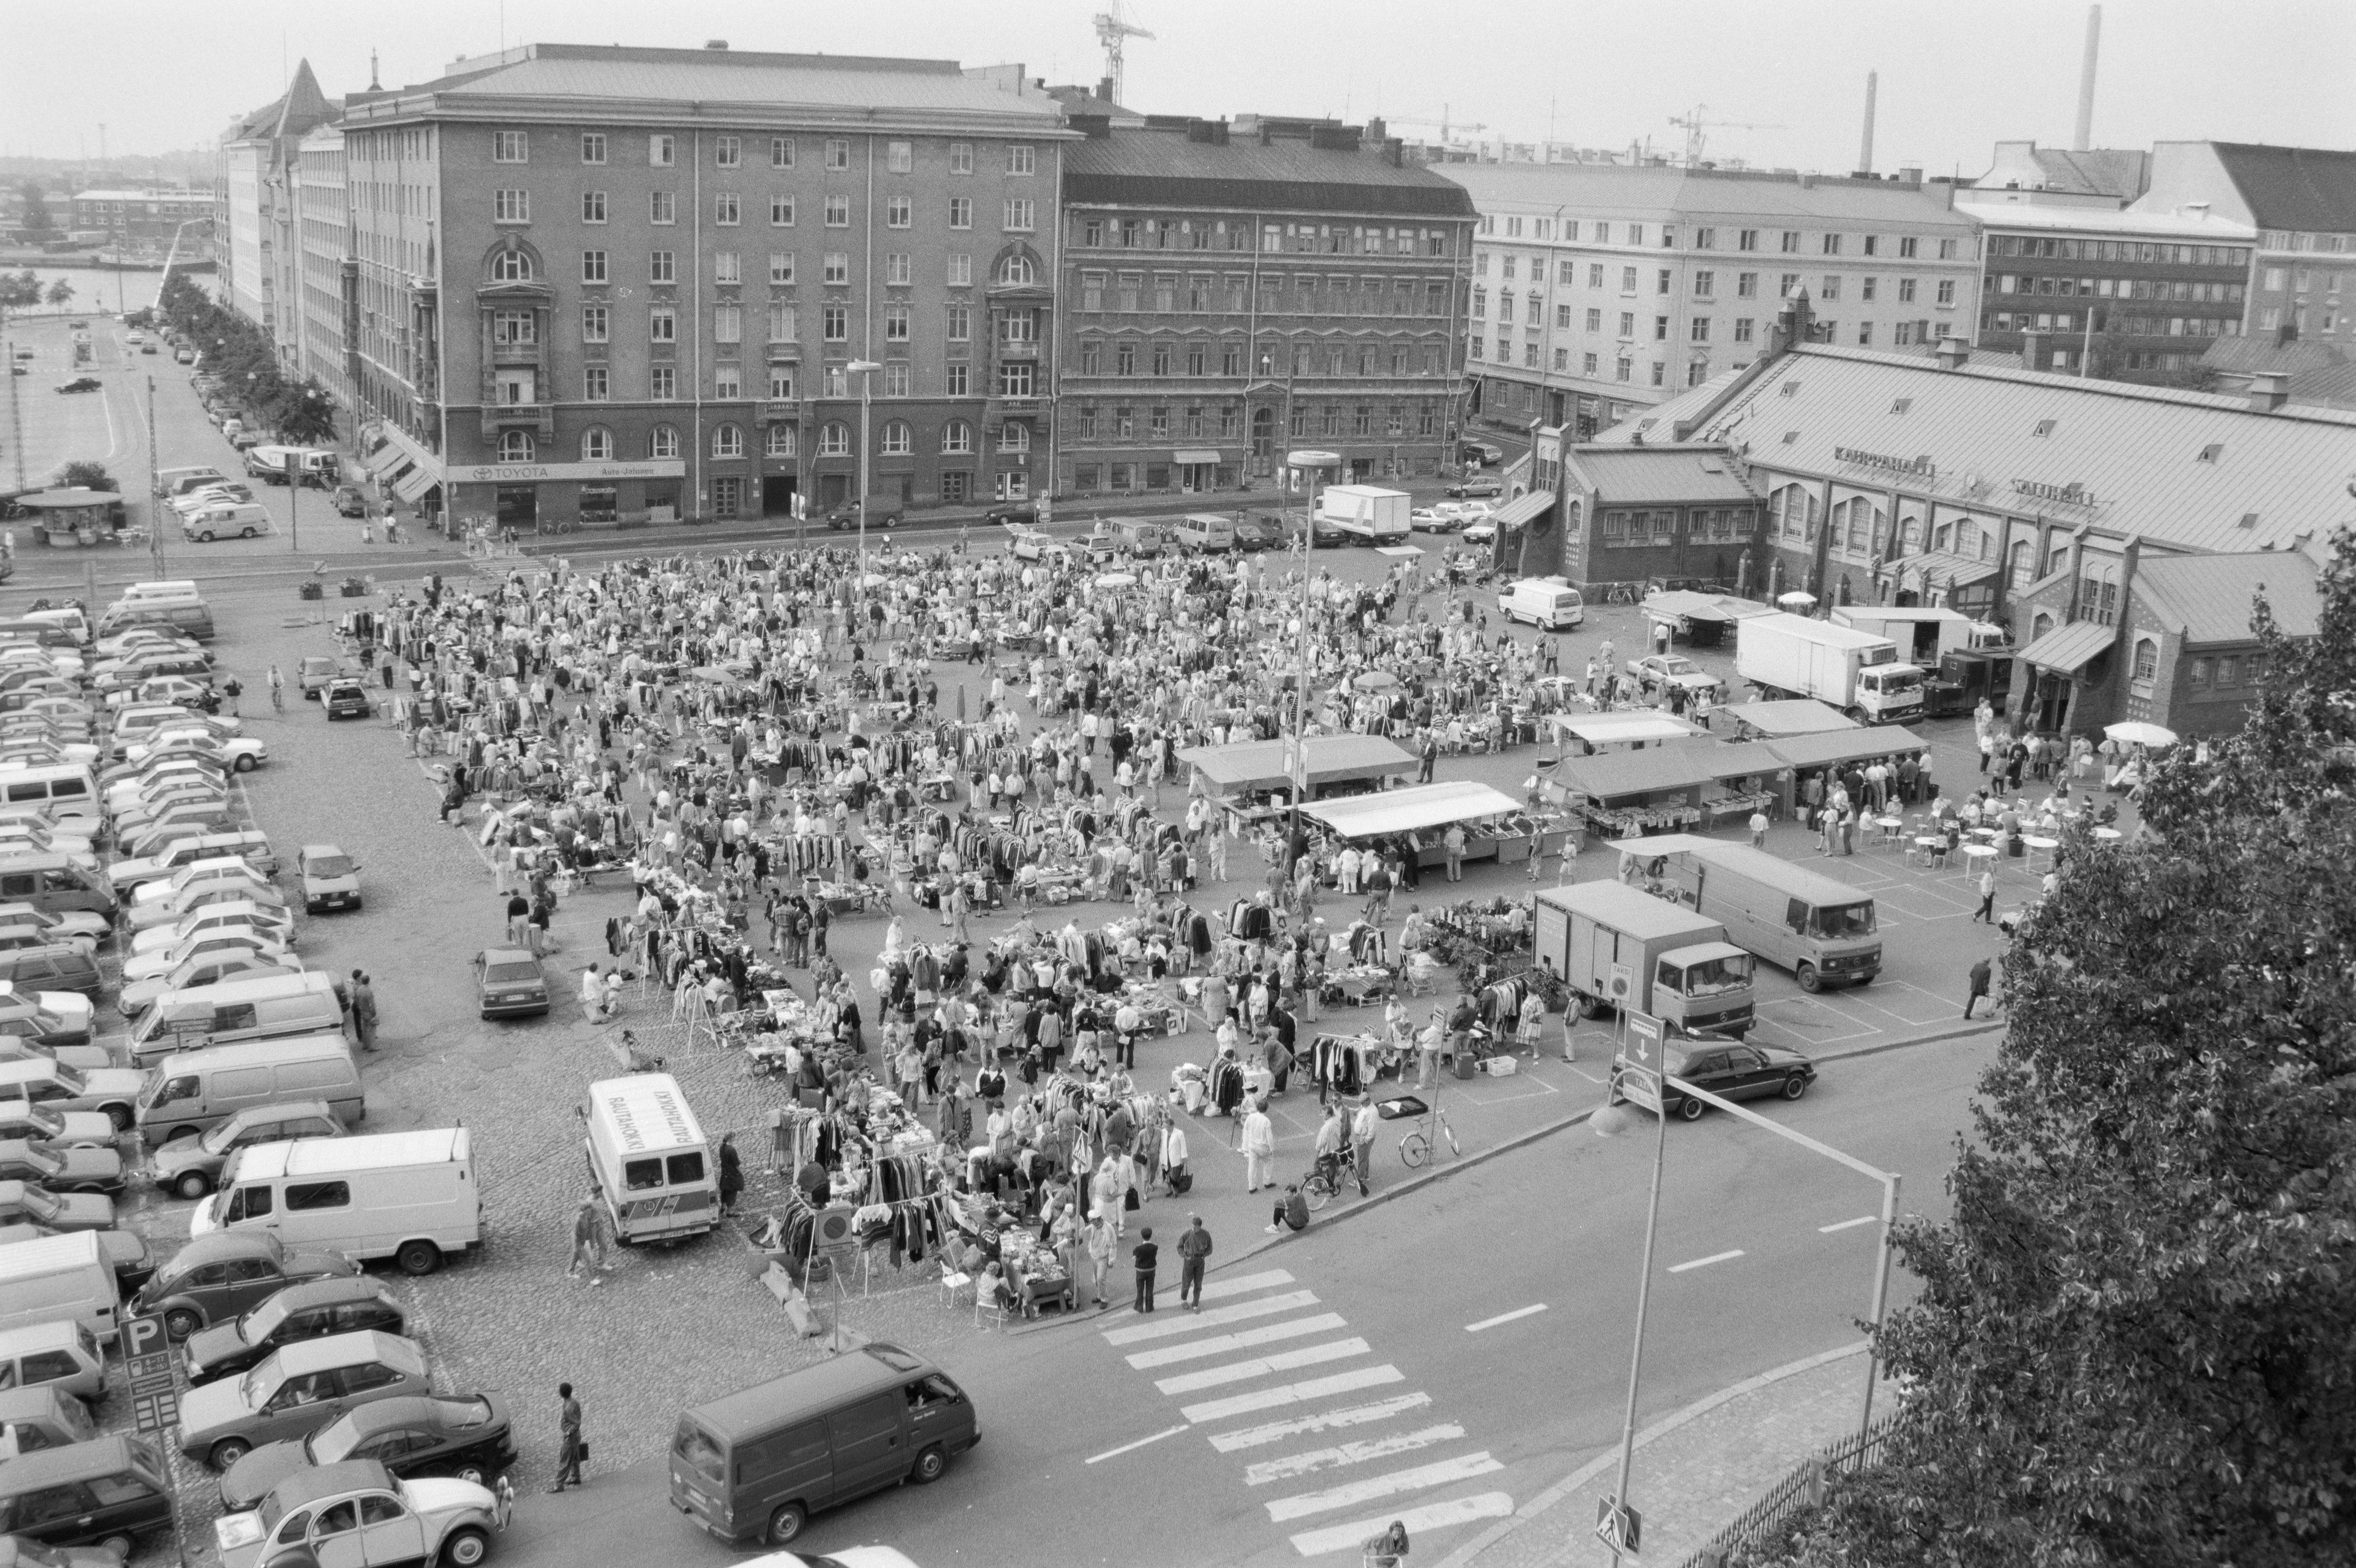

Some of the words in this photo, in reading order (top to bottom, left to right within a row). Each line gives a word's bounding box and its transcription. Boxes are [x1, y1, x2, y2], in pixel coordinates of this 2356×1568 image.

[495, 468, 548, 478] TOYOTA
[1041, 490, 1049, 500] P
[1614, 966, 1630, 976] TAKSI
[608, 1097, 645, 1150] RAUTAHOKKI
[654, 1091, 694, 1144] RAUTAHOKKI
[128, 1319, 158, 1355] P
